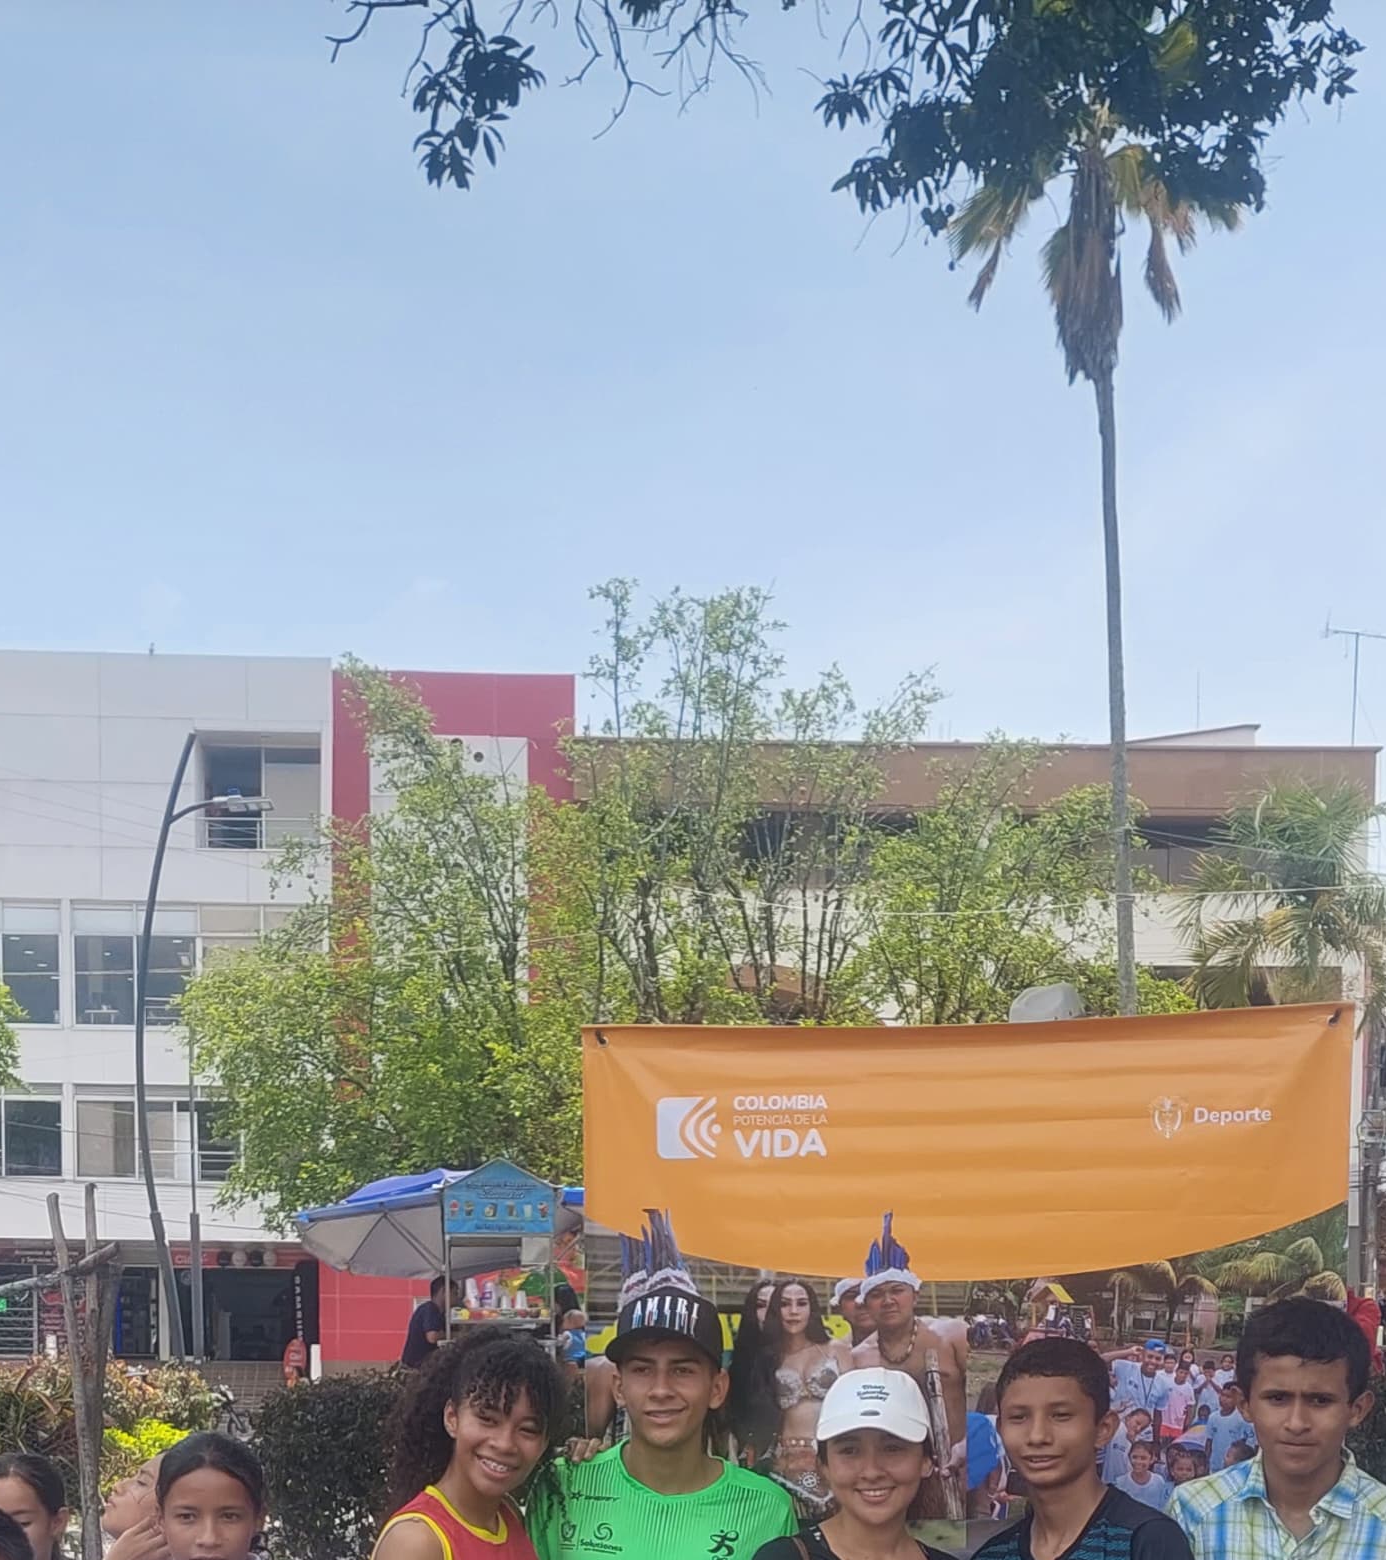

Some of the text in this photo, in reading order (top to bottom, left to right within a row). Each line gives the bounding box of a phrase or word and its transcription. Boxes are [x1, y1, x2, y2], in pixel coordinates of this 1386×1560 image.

[733, 1093, 829, 1111] COLOMBIA
[733, 1113, 829, 1126] POTENCIA DE LA
[1194, 1106, 1273, 1126] Deporte
[733, 1127, 828, 1158] VIDA
